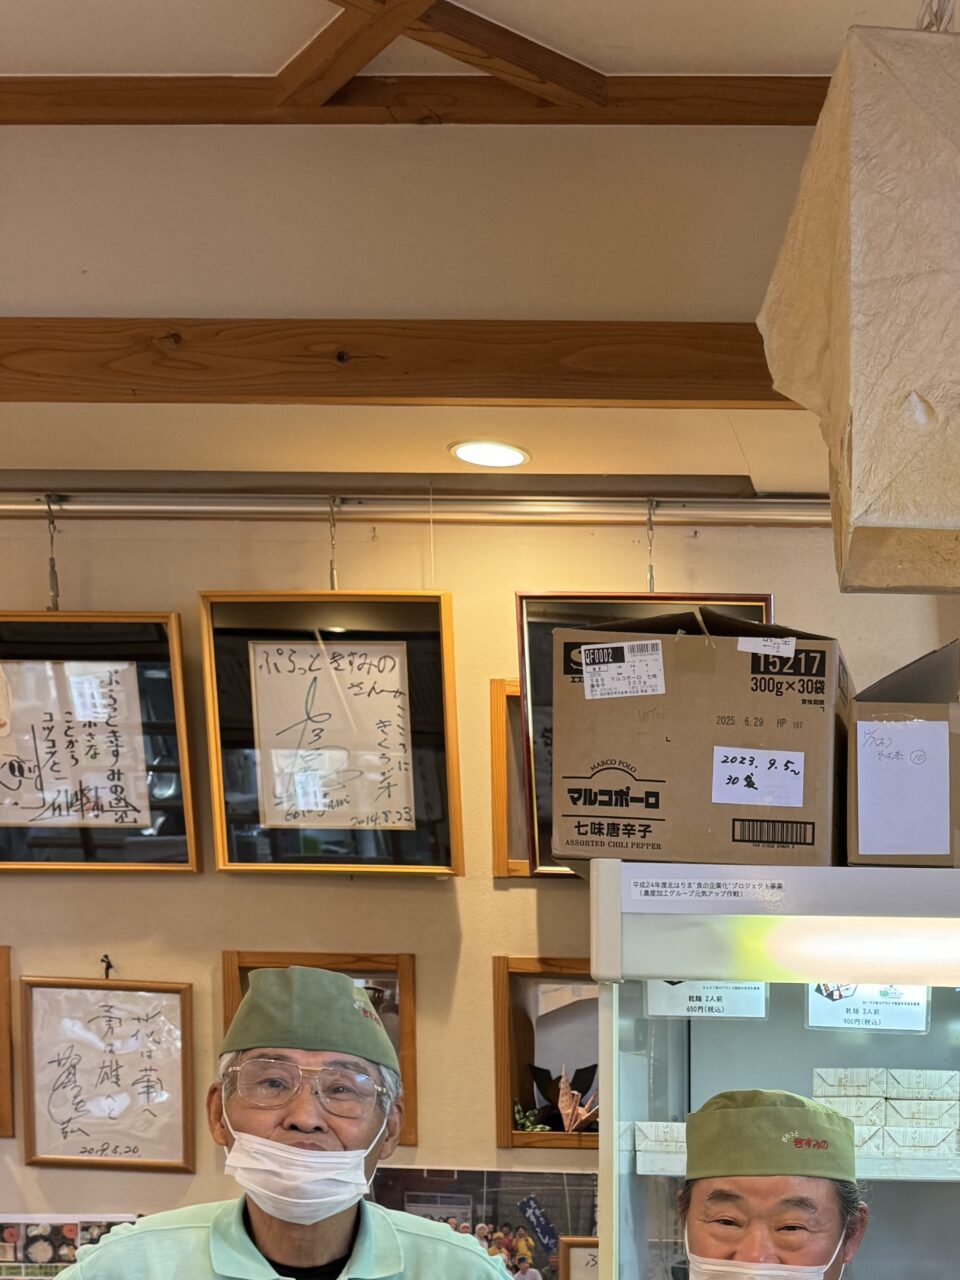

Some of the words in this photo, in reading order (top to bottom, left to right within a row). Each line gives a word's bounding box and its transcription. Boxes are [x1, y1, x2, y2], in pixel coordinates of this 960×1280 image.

[590, 758, 617, 772] MARCO
[615, 759, 637, 773] POLO
[567, 786, 660, 810] マルコポーロ
[574, 821, 653, 839] 七味唐辛子
[565, 839, 605, 847] ASSORTED
